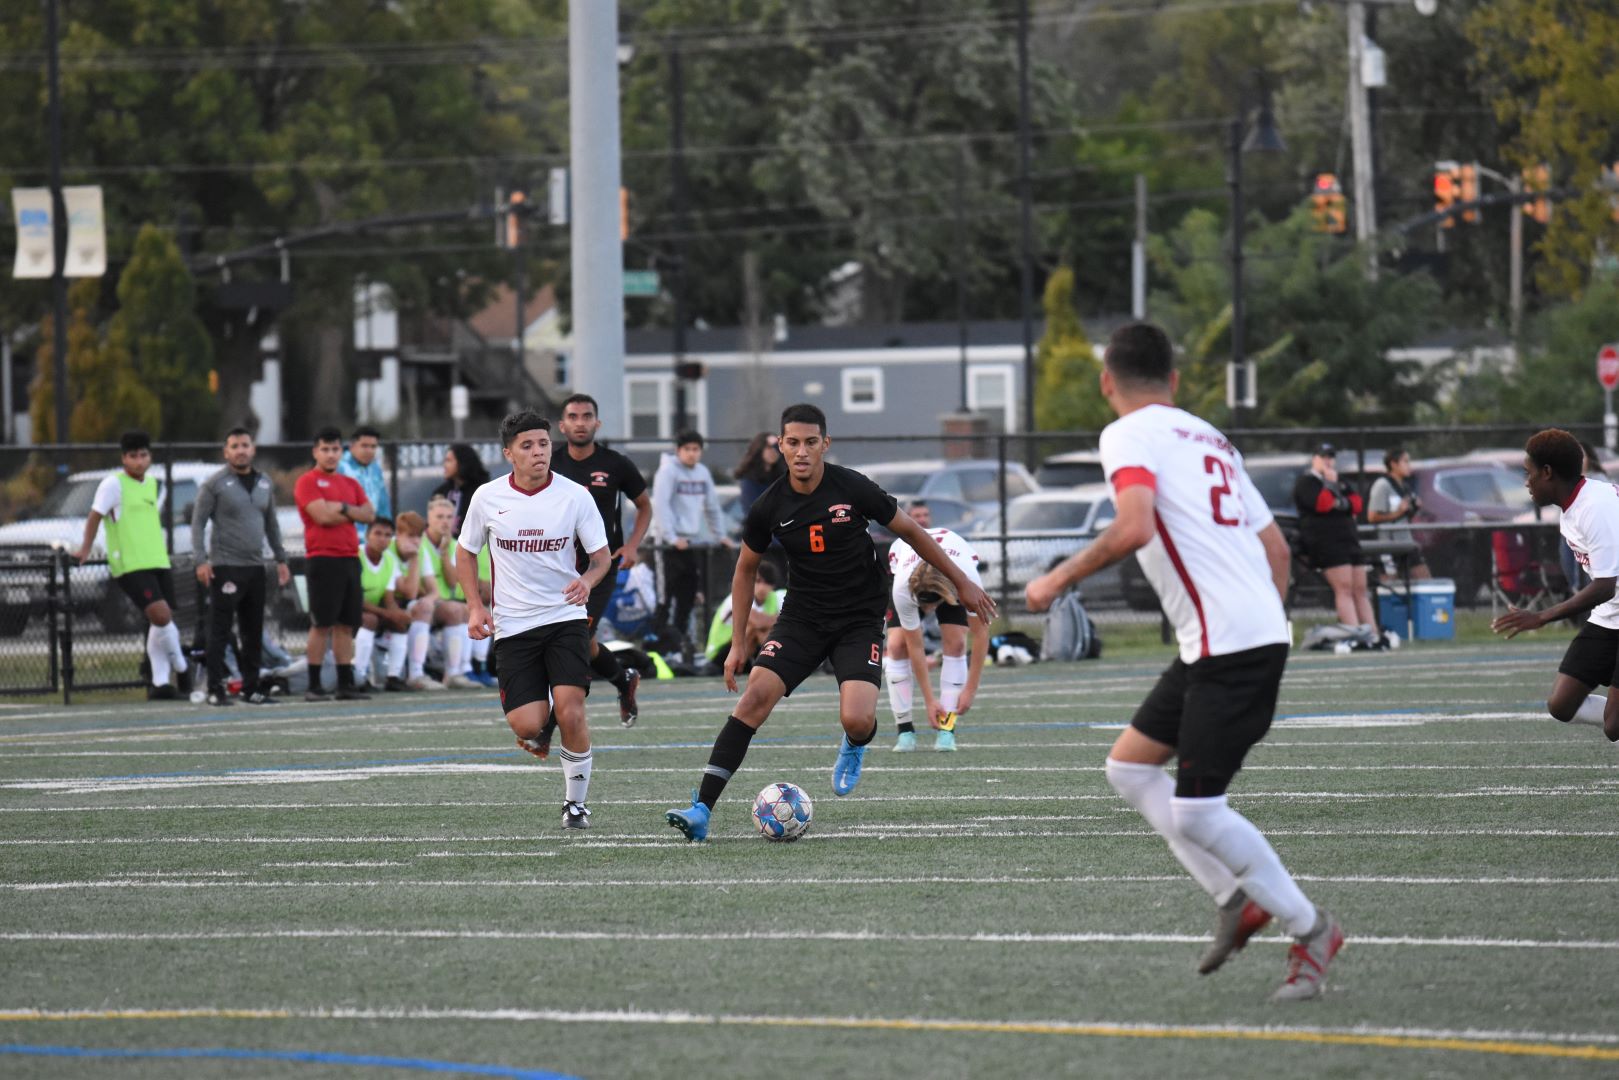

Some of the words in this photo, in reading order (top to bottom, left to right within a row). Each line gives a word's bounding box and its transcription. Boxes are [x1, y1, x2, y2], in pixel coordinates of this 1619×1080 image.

[496, 537, 570, 553] NORTHWEST
[809, 524, 825, 553] 6
[871, 643, 880, 663] 6
